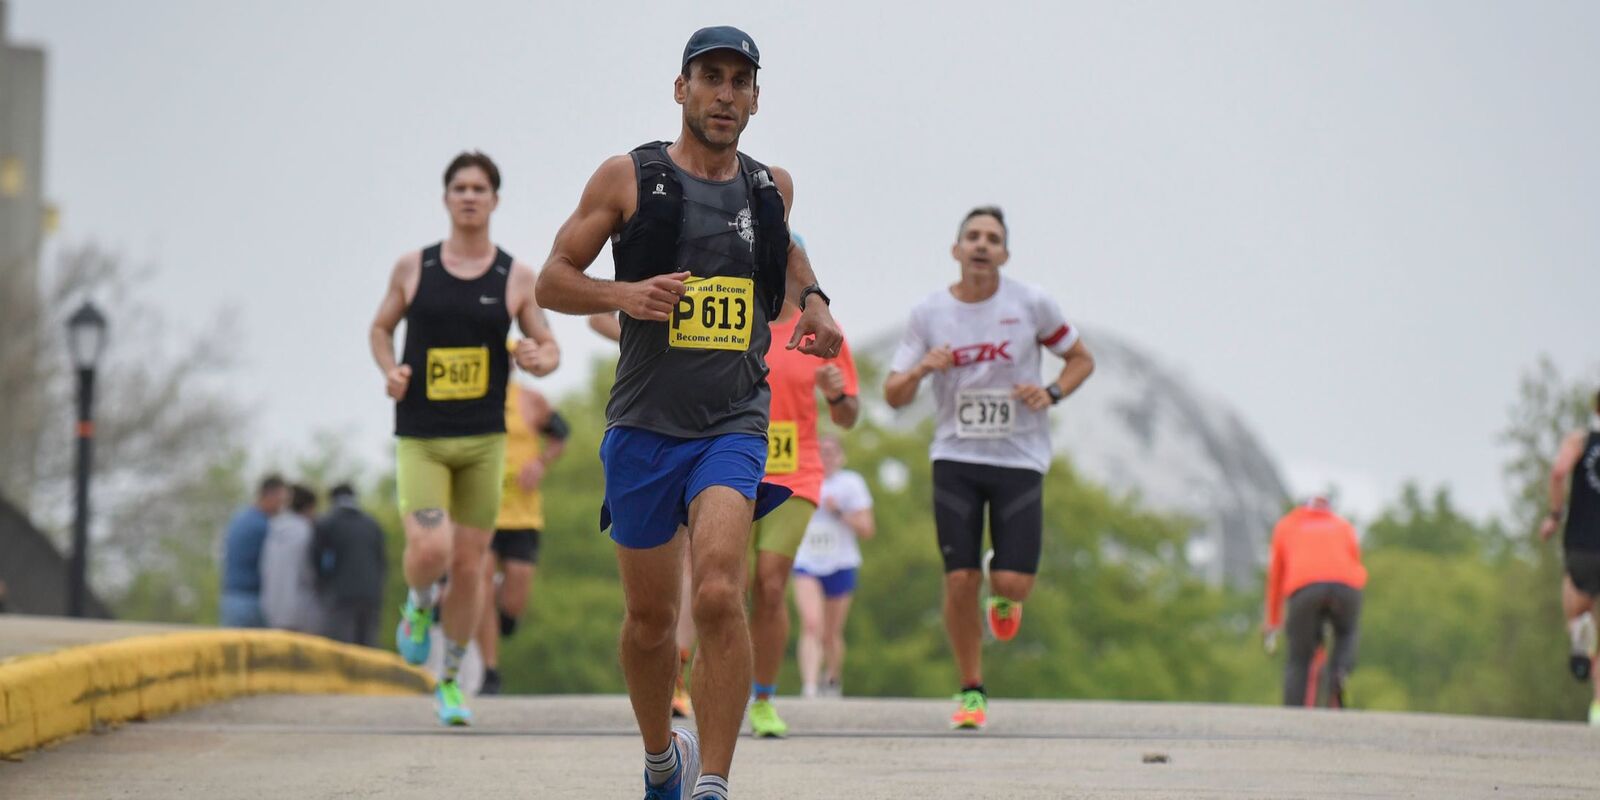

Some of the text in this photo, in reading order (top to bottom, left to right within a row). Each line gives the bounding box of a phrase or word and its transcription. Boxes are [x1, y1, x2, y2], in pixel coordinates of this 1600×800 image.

[698, 284, 713, 292] and
[716, 284, 746, 294] Become
[672, 295, 746, 330] P 613
[676, 333, 710, 342] Become
[713, 335, 729, 343] and
[430, 361, 481, 386] P 607
[959, 402, 1010, 425] C 379
[772, 436, 792, 459] 34
